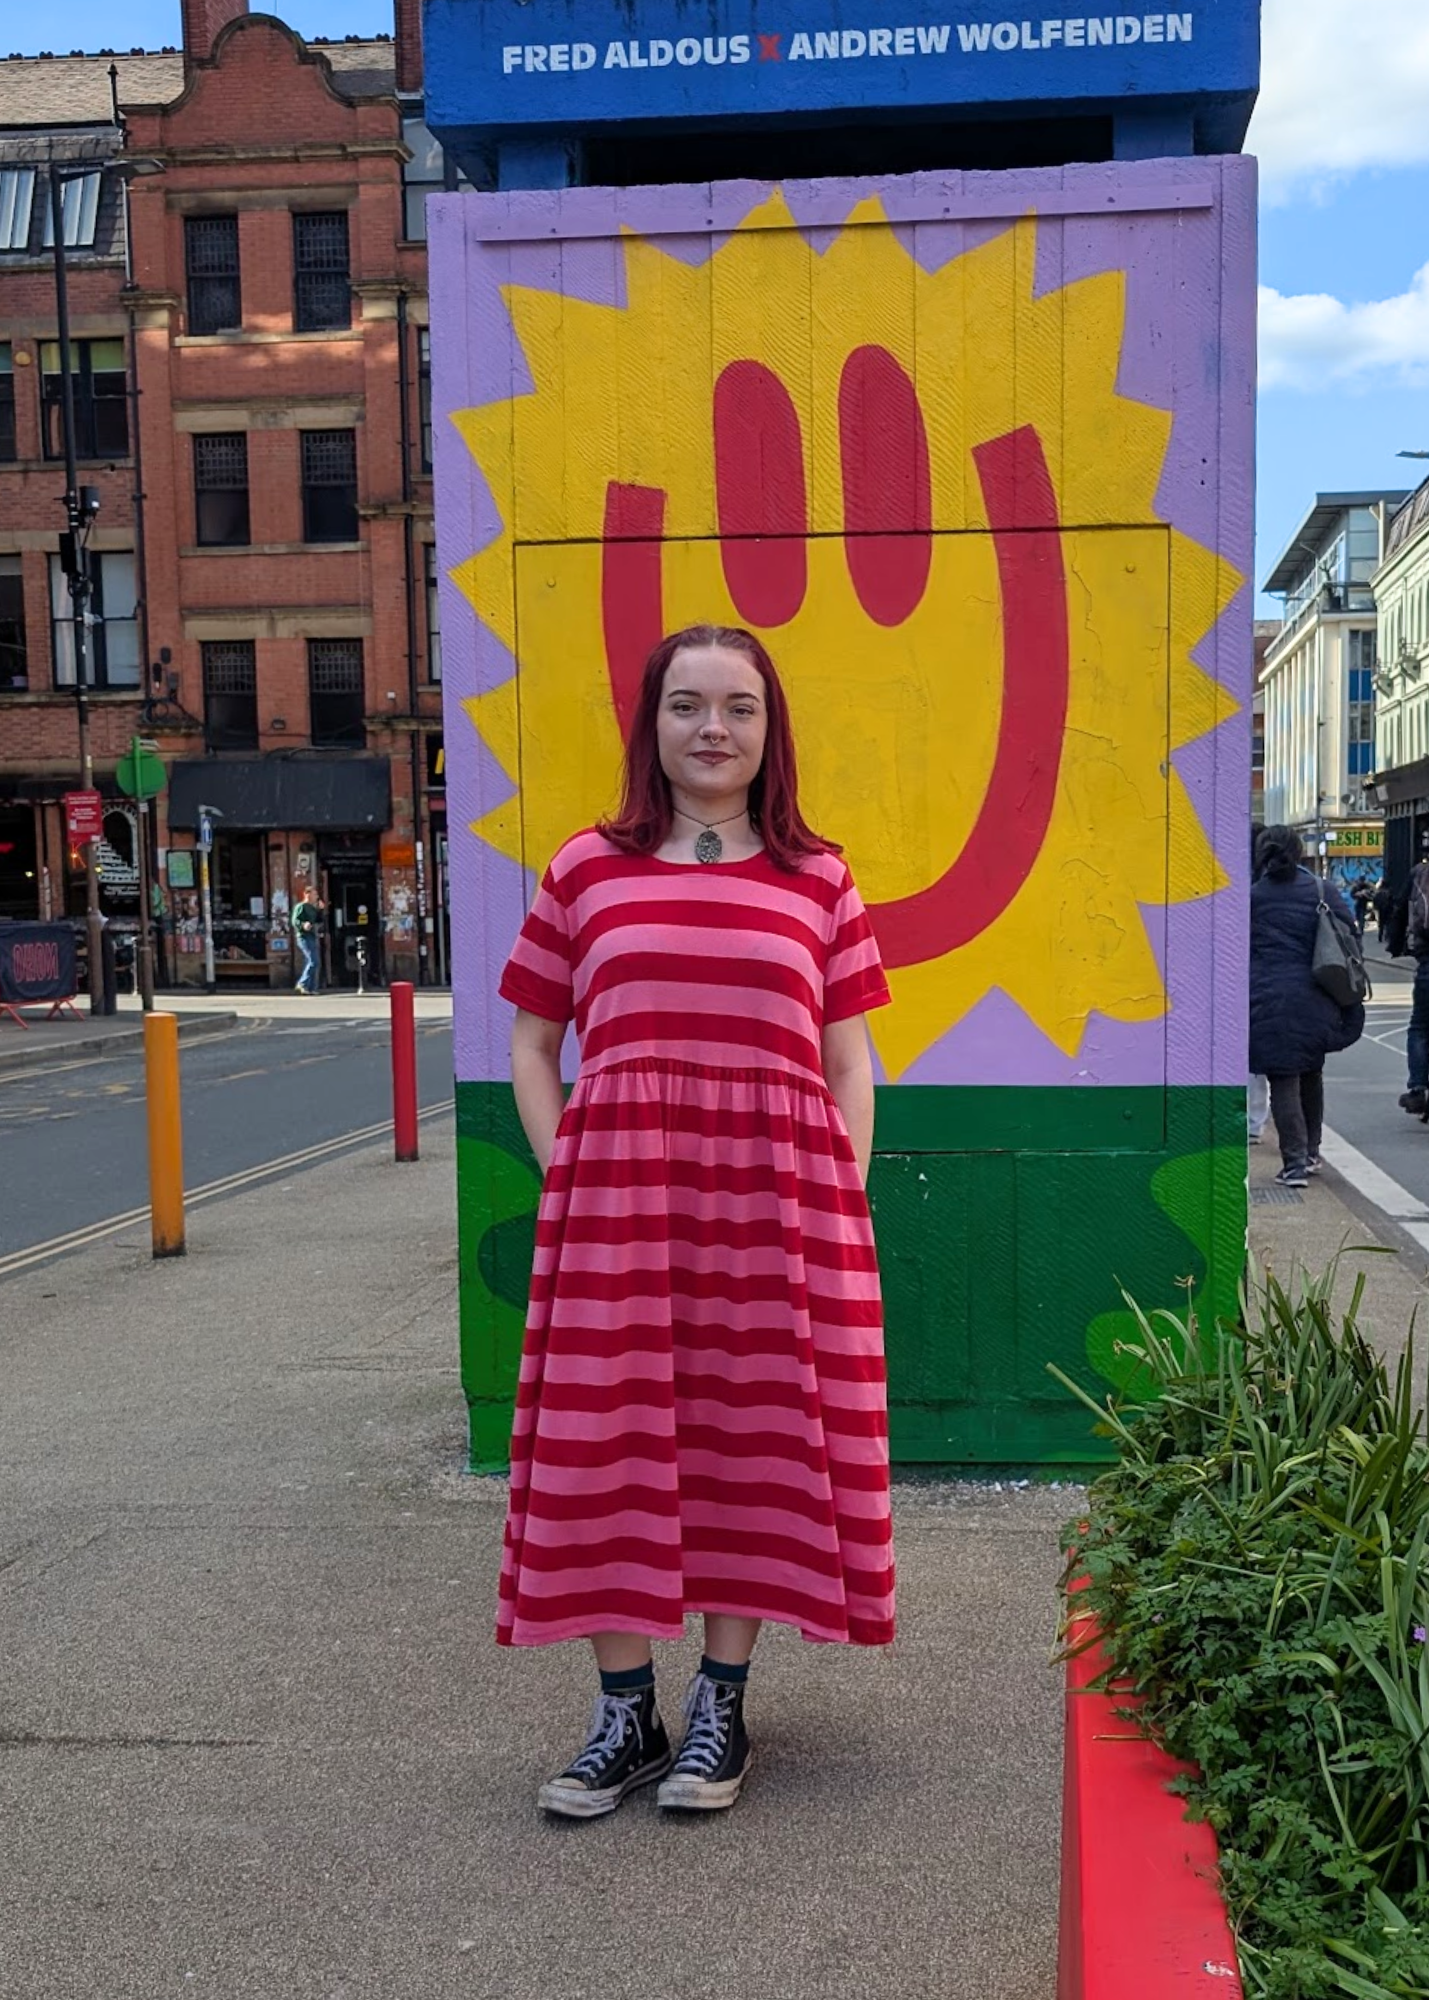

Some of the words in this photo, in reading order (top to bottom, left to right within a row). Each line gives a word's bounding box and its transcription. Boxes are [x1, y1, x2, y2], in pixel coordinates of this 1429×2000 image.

[502, 42, 597, 74] FRED
[603, 34, 751, 69] ALDOUS
[787, 25, 951, 61] ANDREW
[957, 13, 1193, 52] WOLFENDEN
